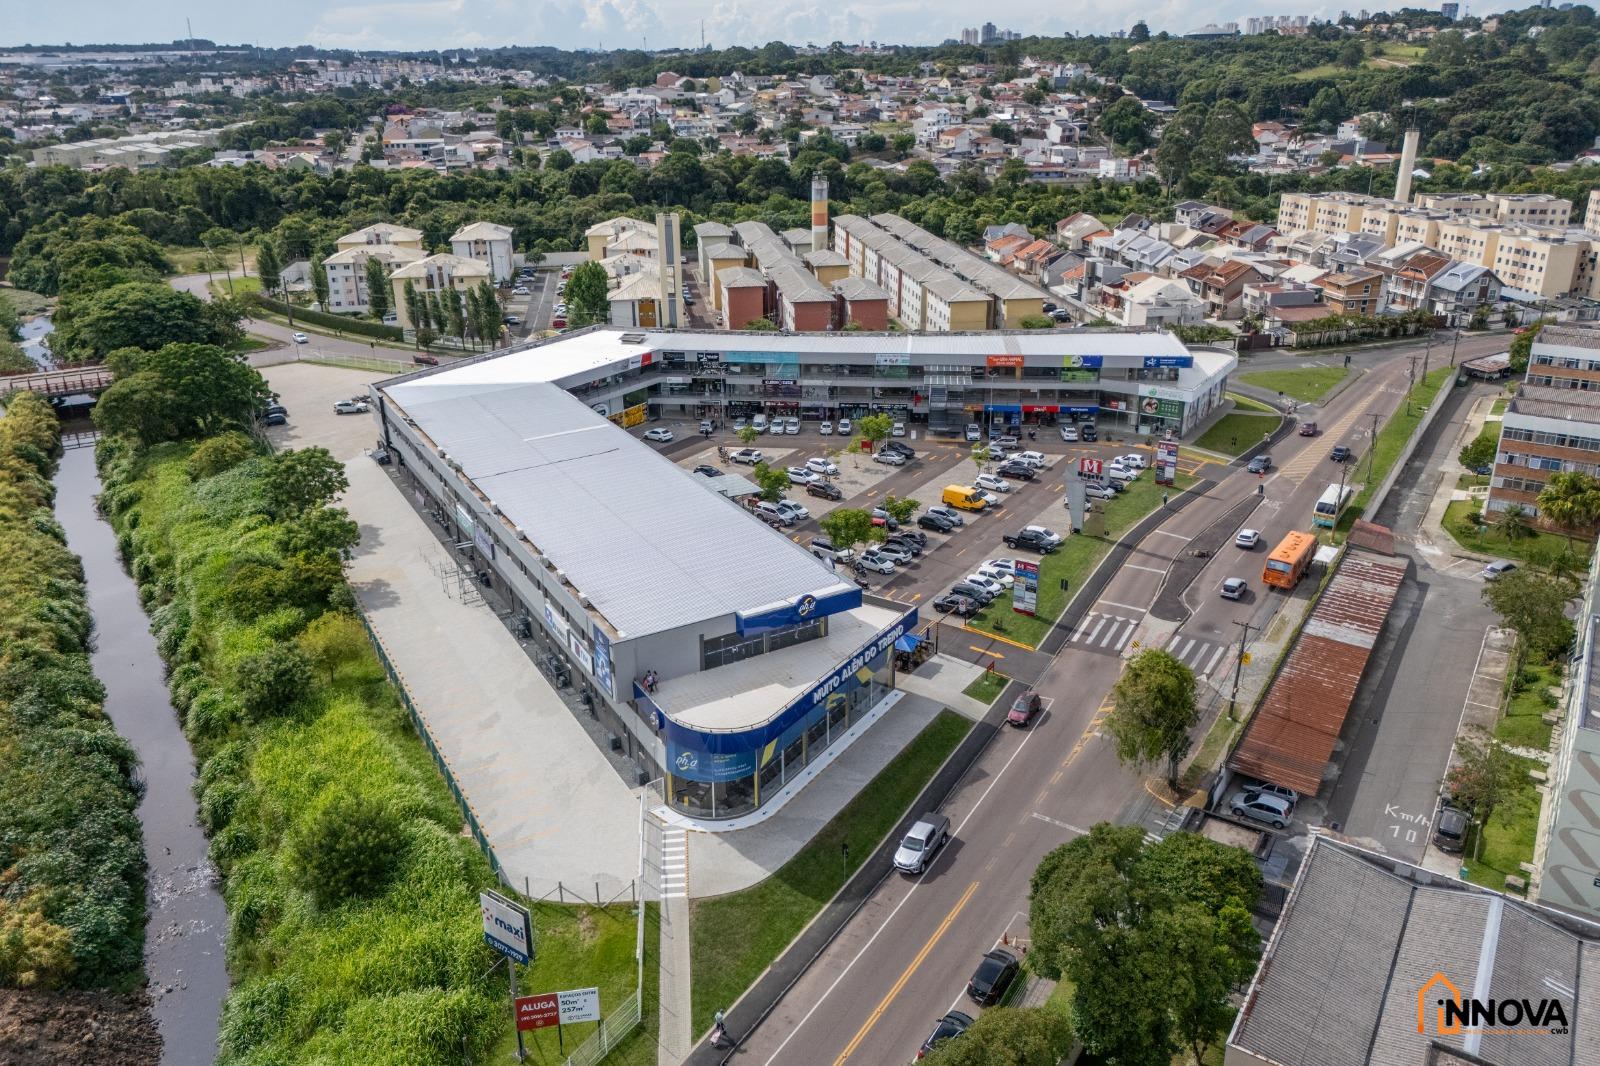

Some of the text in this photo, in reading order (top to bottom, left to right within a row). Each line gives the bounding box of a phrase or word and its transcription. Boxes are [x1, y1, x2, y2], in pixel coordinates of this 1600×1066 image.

[813, 624, 904, 704] MUITO ALÉM DO TREINO
[494, 916, 525, 940] maxi
[521, 1000, 556, 1012] ALUGA
